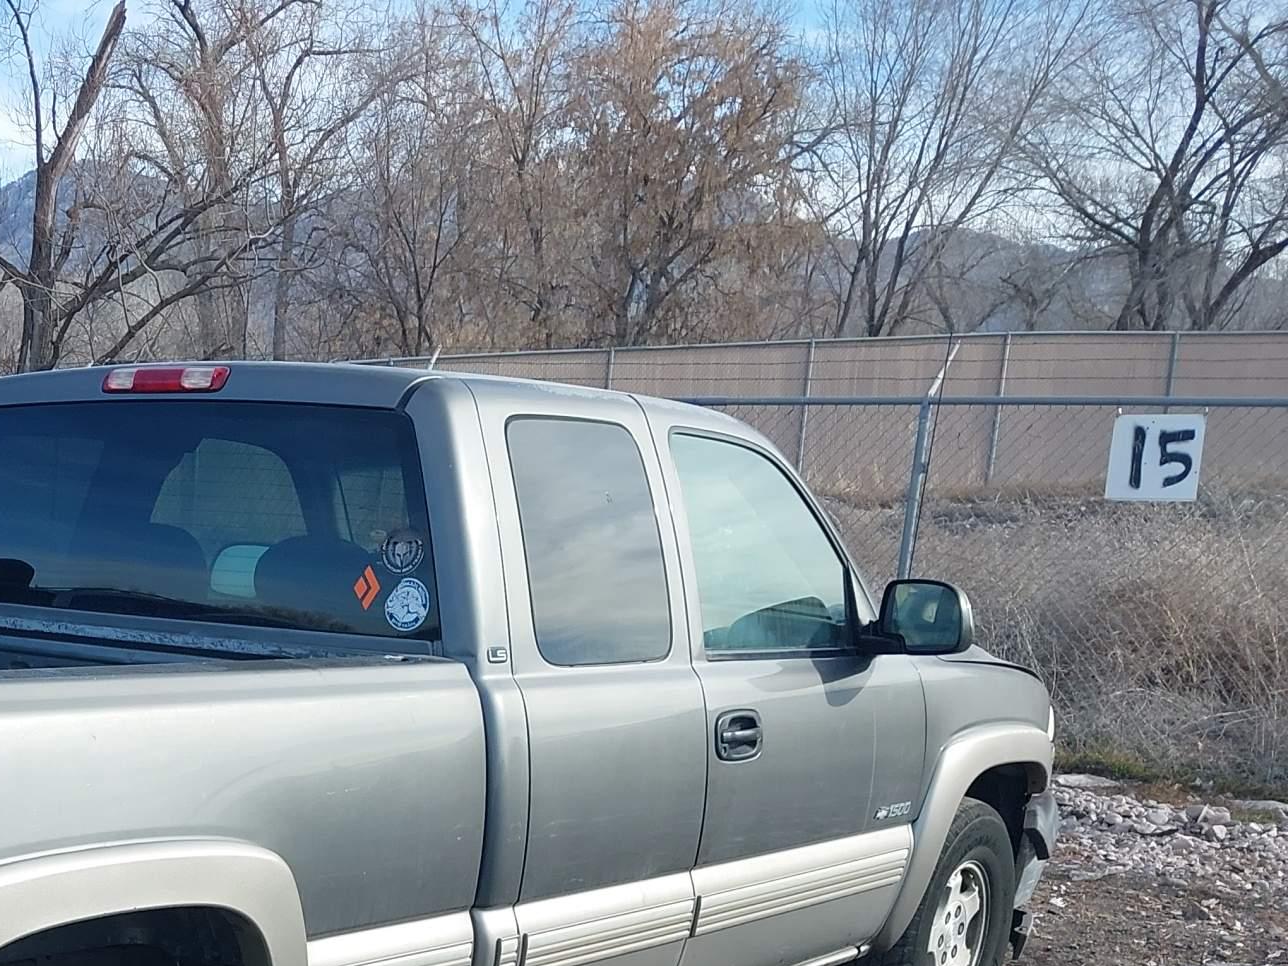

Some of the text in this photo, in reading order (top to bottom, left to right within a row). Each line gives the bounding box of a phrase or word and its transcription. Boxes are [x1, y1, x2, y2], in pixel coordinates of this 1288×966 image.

[1129, 425, 1196, 490] 15
[488, 647, 508, 662] LS
[888, 800, 912, 818] 1500
